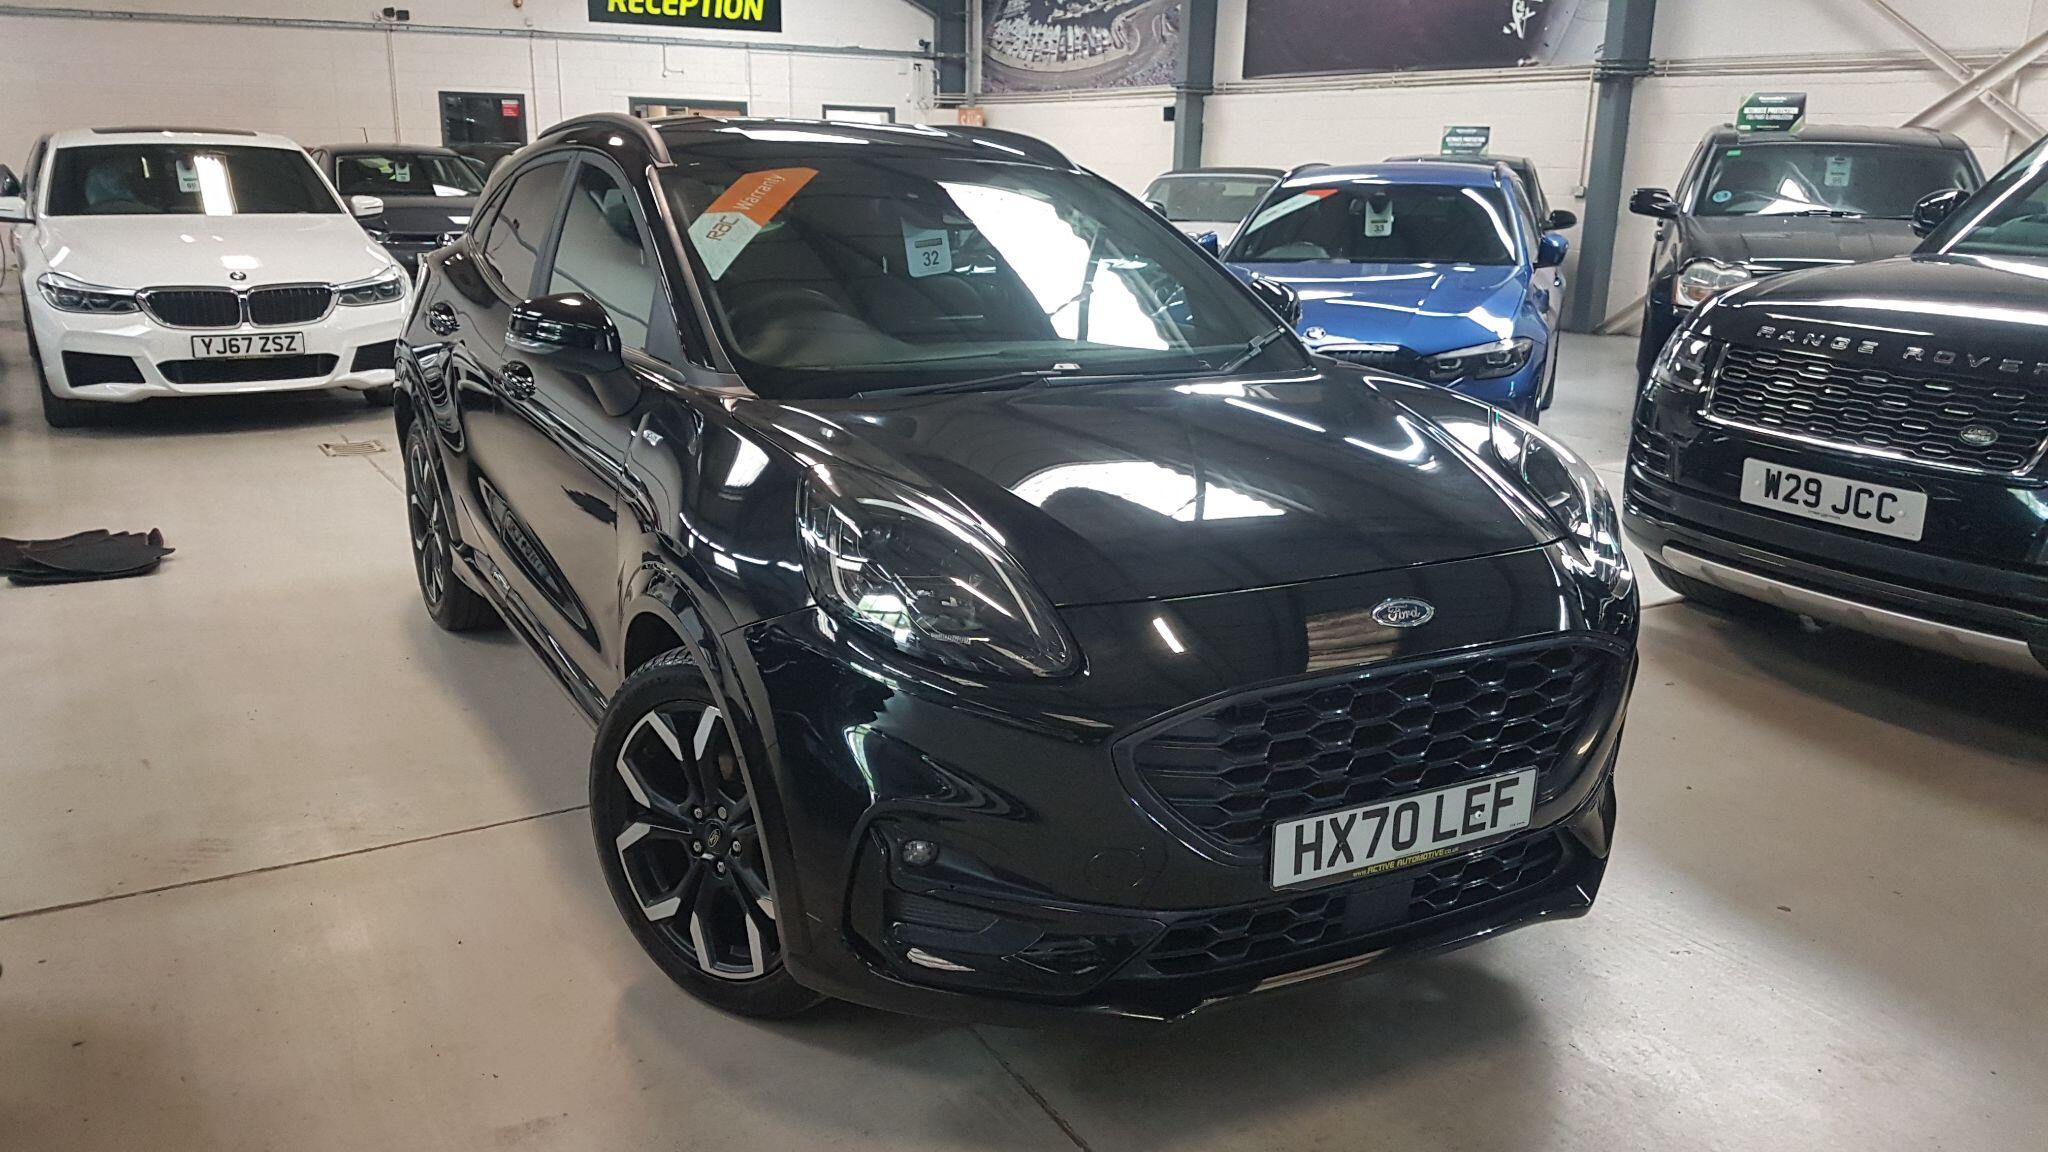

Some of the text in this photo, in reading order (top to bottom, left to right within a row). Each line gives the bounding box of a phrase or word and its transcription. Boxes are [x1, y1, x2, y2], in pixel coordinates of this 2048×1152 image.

[607, 0, 764, 21] RECEPTION
[733, 174, 785, 211] Warranty
[922, 250, 940, 267] 32
[201, 335, 297, 355] YJ67 ZSZ
[1756, 325, 1879, 355] RANGE
[1763, 467, 1898, 524] W29 JCC
[1387, 604, 1421, 622] Ford
[1293, 776, 1520, 876] HX70 LEF
